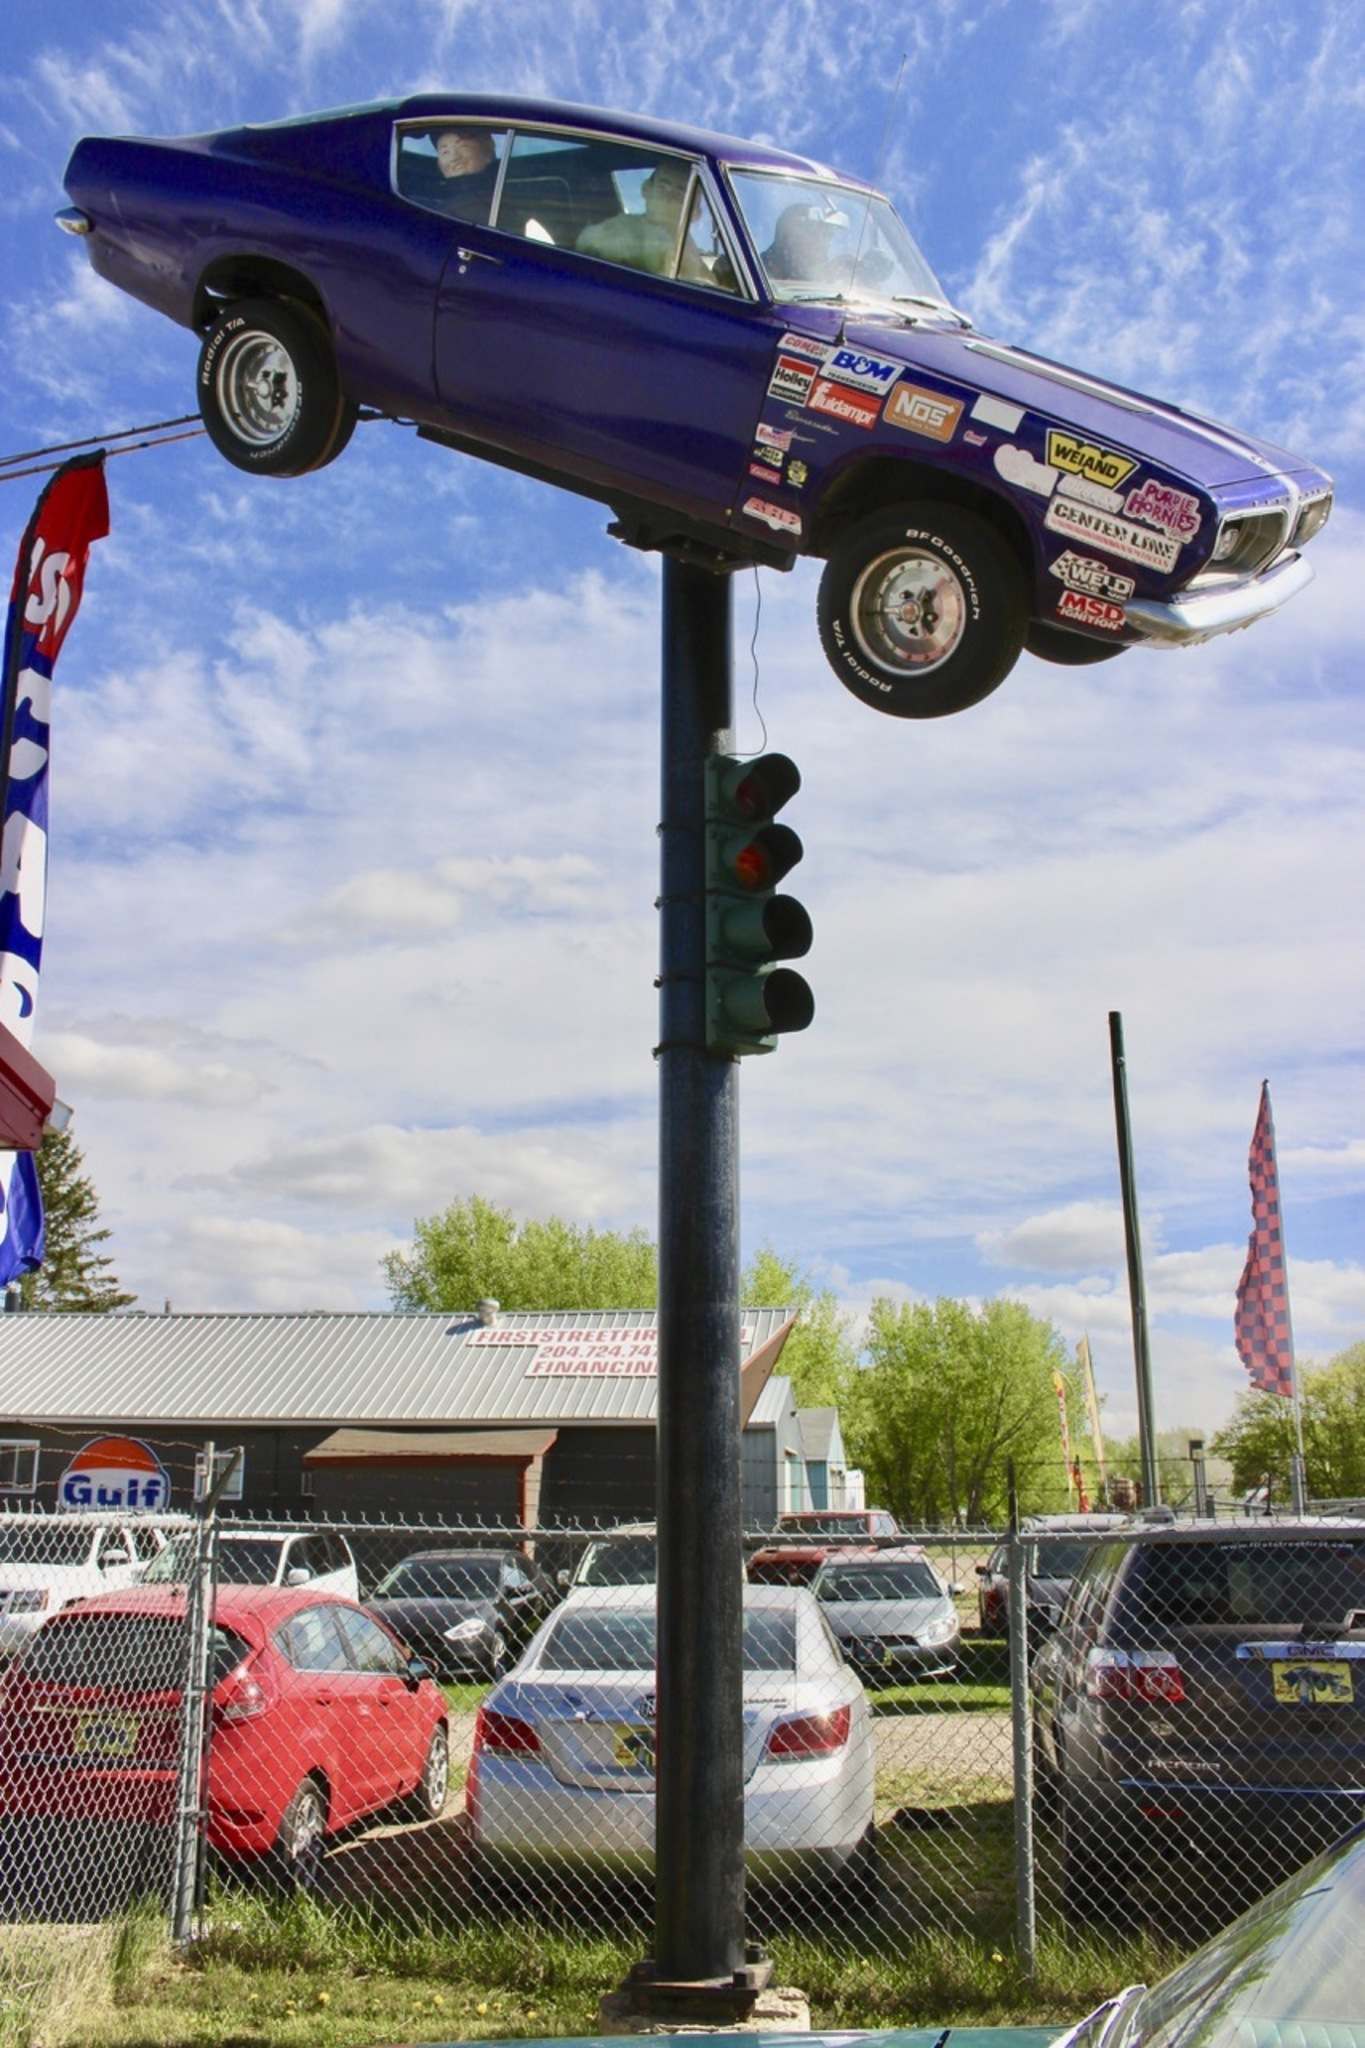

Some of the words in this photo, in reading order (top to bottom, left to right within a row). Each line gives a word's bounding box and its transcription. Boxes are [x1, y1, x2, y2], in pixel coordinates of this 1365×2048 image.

[226, 318, 246, 331] T/A
[774, 367, 812, 392] Holley
[832, 351, 895, 381] B&M
[894, 390, 954, 427] NOS
[1055, 444, 1119, 478] WEIAND
[1127, 492, 1197, 532] HORNIES
[1145, 484, 1194, 512] PURPLE
[1053, 503, 1128, 541] CENTER
[1069, 562, 1132, 597] WELD
[1060, 606, 1121, 631] IGNITION
[1062, 593, 1127, 623] MSD
[476, 1326, 747, 1343] FIRSTSTREETFIR
[532, 1361, 657, 1375] FINANCIN
[63, 1474, 163, 1507] Gulf
[1287, 1645, 1336, 1656] GMC
